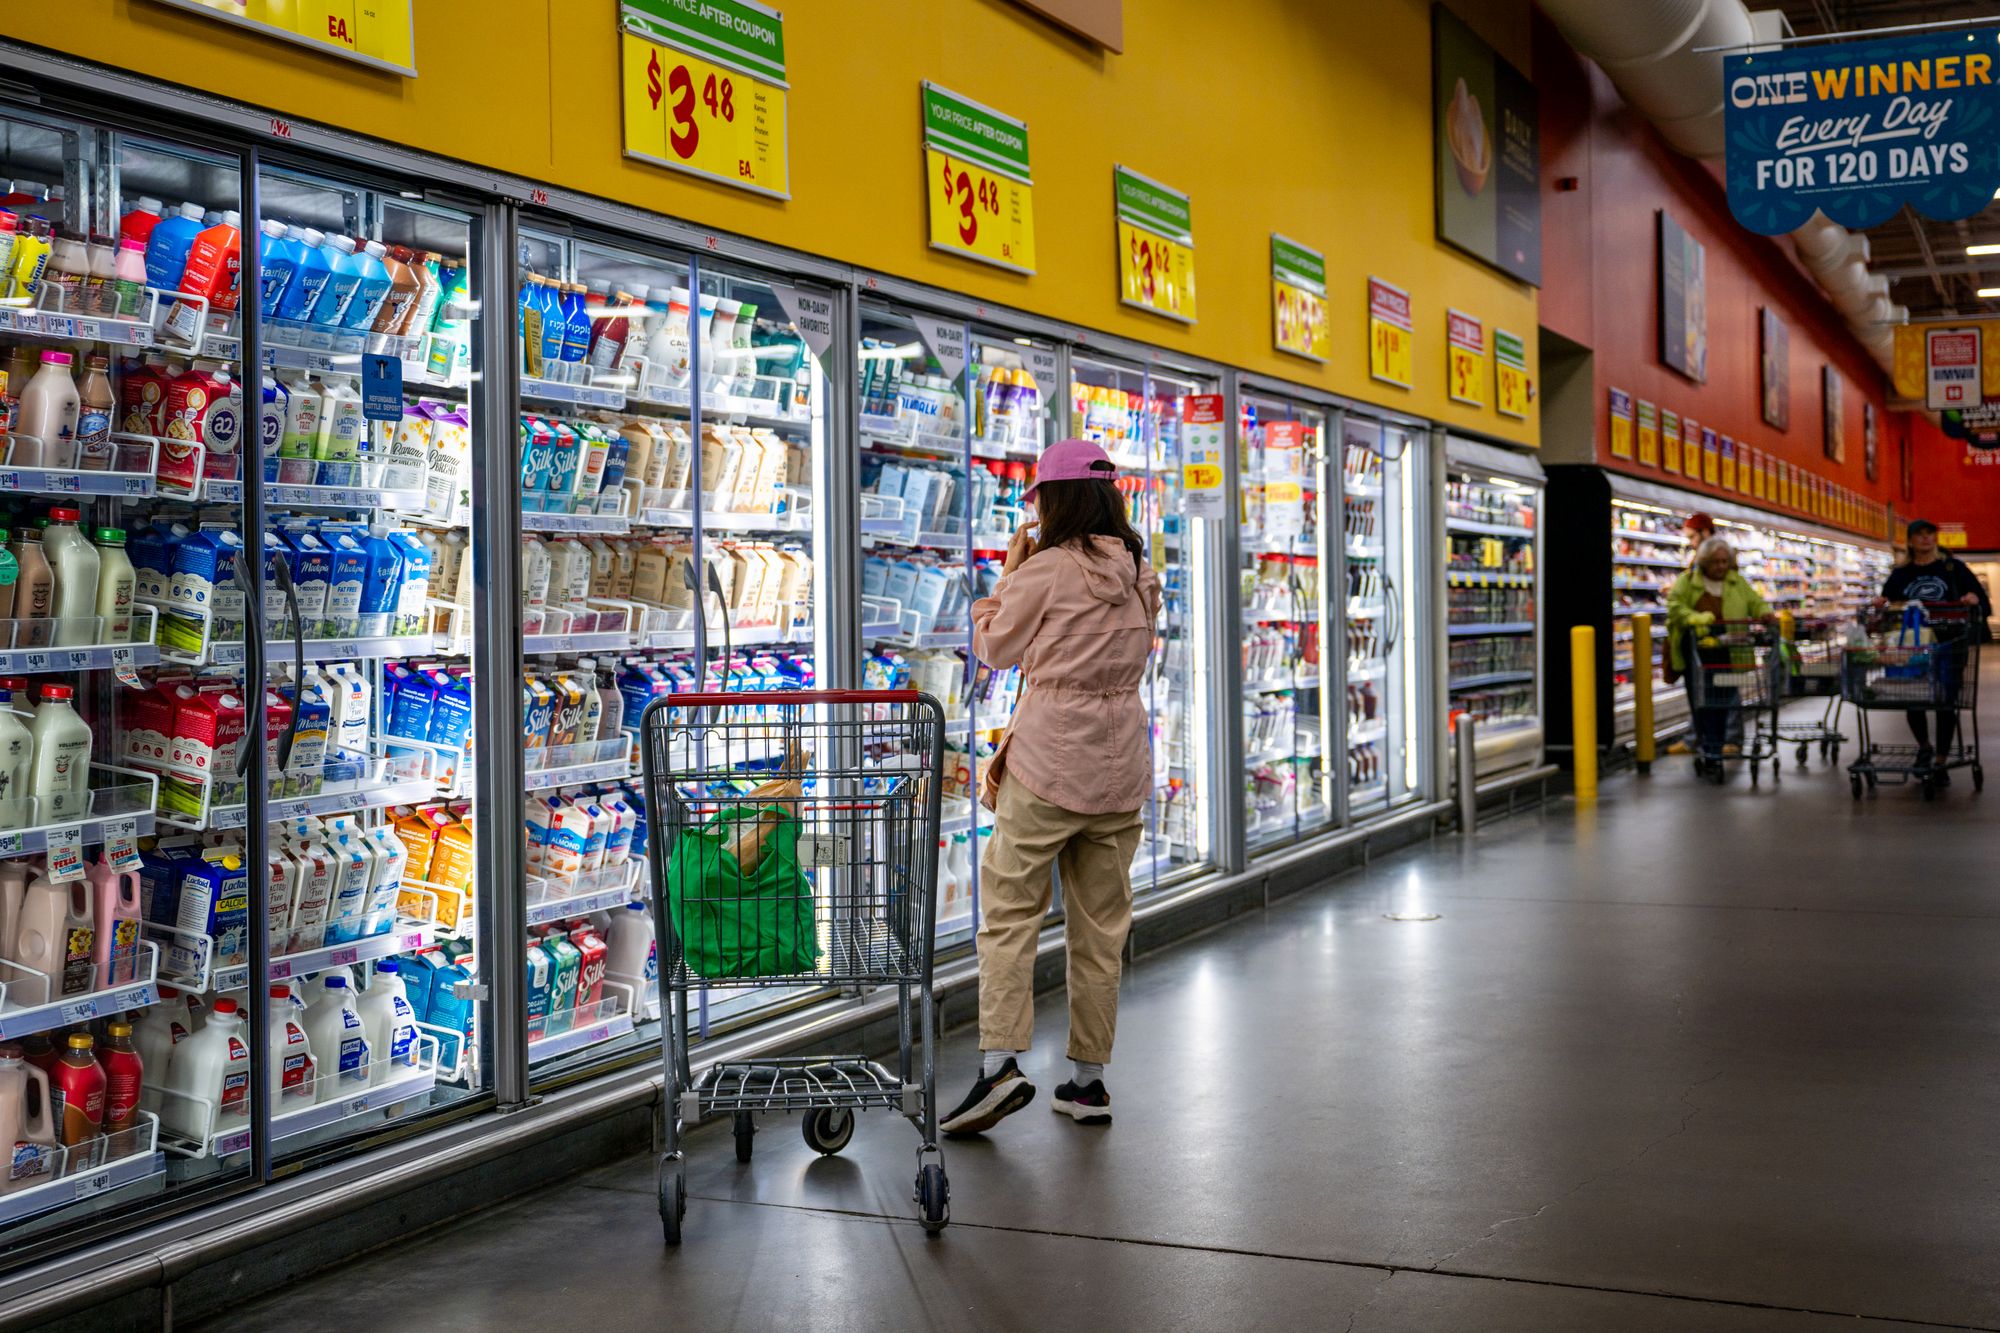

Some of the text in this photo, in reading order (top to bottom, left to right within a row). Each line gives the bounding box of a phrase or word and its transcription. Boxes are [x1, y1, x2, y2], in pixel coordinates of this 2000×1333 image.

[328, 15, 353, 44] EA.
[699, 3, 733, 29] AFTER
[734, 16, 776, 46] COUPON
[1731, 53, 1992, 109] ONE WINNER
[271, 118, 292, 139] A22
[931, 102, 1024, 151] YOUR PRICE AFTER COUPON
[1776, 95, 1953, 149] Every Day
[738, 159, 755, 180] EA.
[1757, 156, 1815, 191] FOR
[1825, 150, 1878, 185] 120
[1889, 142, 1969, 179] DAYS
[532, 189, 548, 205] A23
[27, 253, 48, 294] Nesquik
[797, 296, 830, 315] NON-DAIRY
[799, 316, 830, 337] FAVORITES
[936, 326, 964, 344] NON-DAIRY
[937, 343, 964, 361] FAVORITES
[365, 402, 402, 412] BOTTLE DEPOSIT
[369, 395, 397, 404] REFUNDABLE
[213, 416, 233, 435] a2
[393, 442, 425, 460] Banana
[429, 449, 461, 470] Banana
[523, 447, 554, 475] Silk
[549, 450, 578, 477] Silk
[607, 457, 626, 467] DREAM
[301, 561, 329, 574] Mootopia
[337, 561, 364, 574] Mootopia
[298, 719, 328, 731] Mootopia
[524, 705, 554, 736] Silk
[553, 705, 583, 734] Silk
[218, 723, 245, 737] Mootop
[65, 829, 80, 840] $548
[121, 822, 135, 833] $548
[551, 837, 580, 850] ALMOND
[110, 848, 133, 860] TEXAS
[53, 856, 77, 870] TEXAS
[187, 875, 209, 888] Lactaid
[269, 883, 286, 891] ACTOSE
[308, 878, 327, 887] LACTOSE
[270, 892, 283, 904] Free
[309, 887, 323, 899] Free
[220, 897, 246, 909] CALCIU
[551, 966, 580, 999] Silk
[579, 959, 606, 992] Silk
[343, 1042, 360, 1051] Lactaid
[286, 1056, 305, 1068] Lactaid
[226, 1076, 245, 1086] Lactaid
